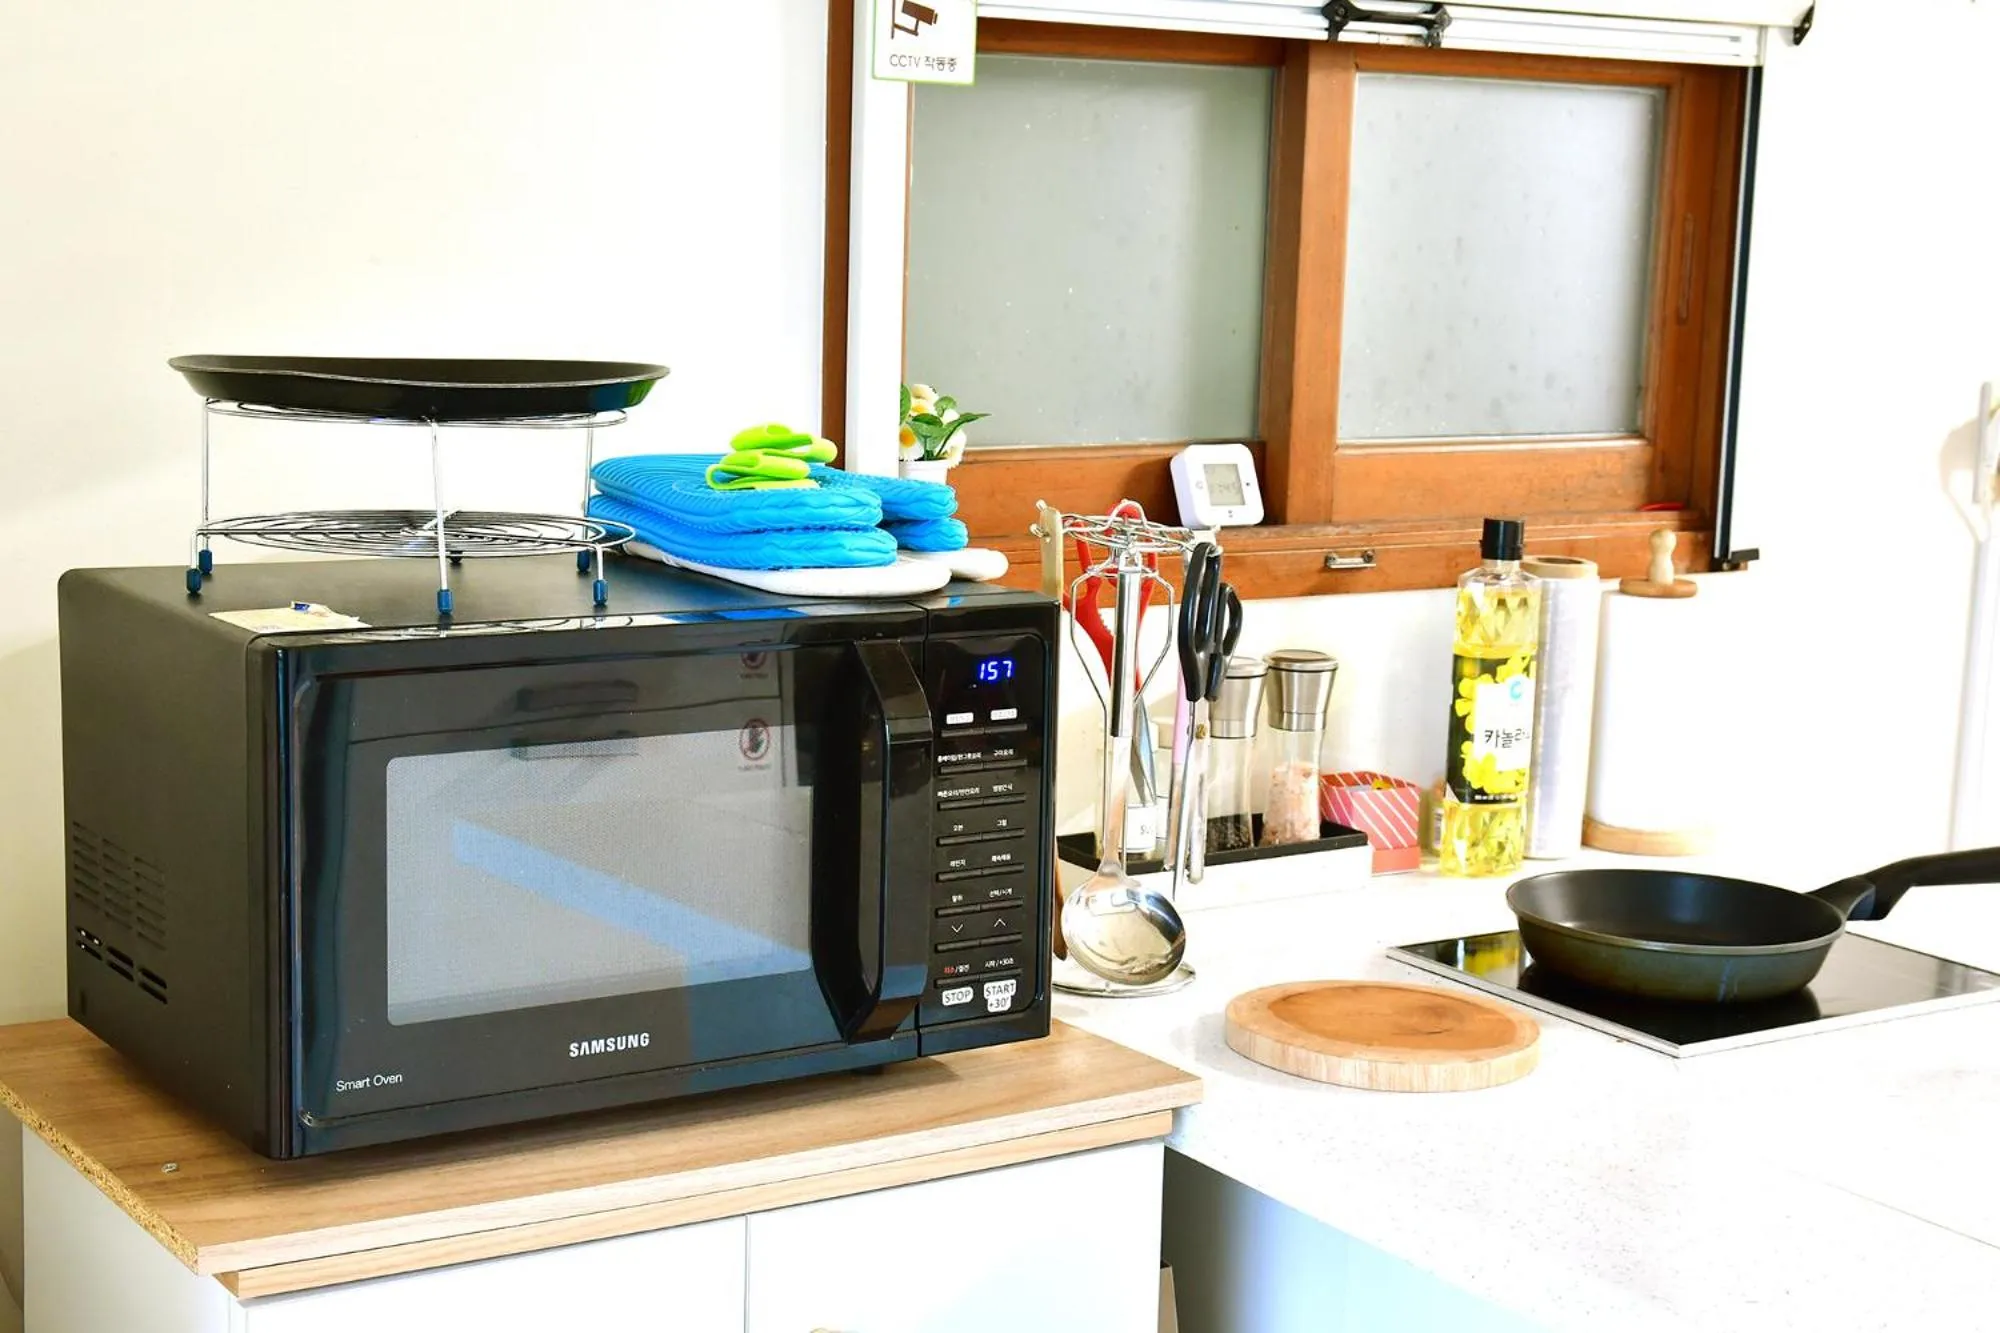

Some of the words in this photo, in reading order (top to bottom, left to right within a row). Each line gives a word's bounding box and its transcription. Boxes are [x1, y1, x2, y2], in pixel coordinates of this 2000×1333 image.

[889, 53, 921, 68] CCTV
[924, 55, 957, 73] 작동중
[944, 990, 972, 1003] STOP
[985, 982, 1016, 998] START
[570, 1033, 649, 1057] SAMSUNG
[335, 1076, 371, 1092] Smart
[373, 1074, 403, 1086] Oven
